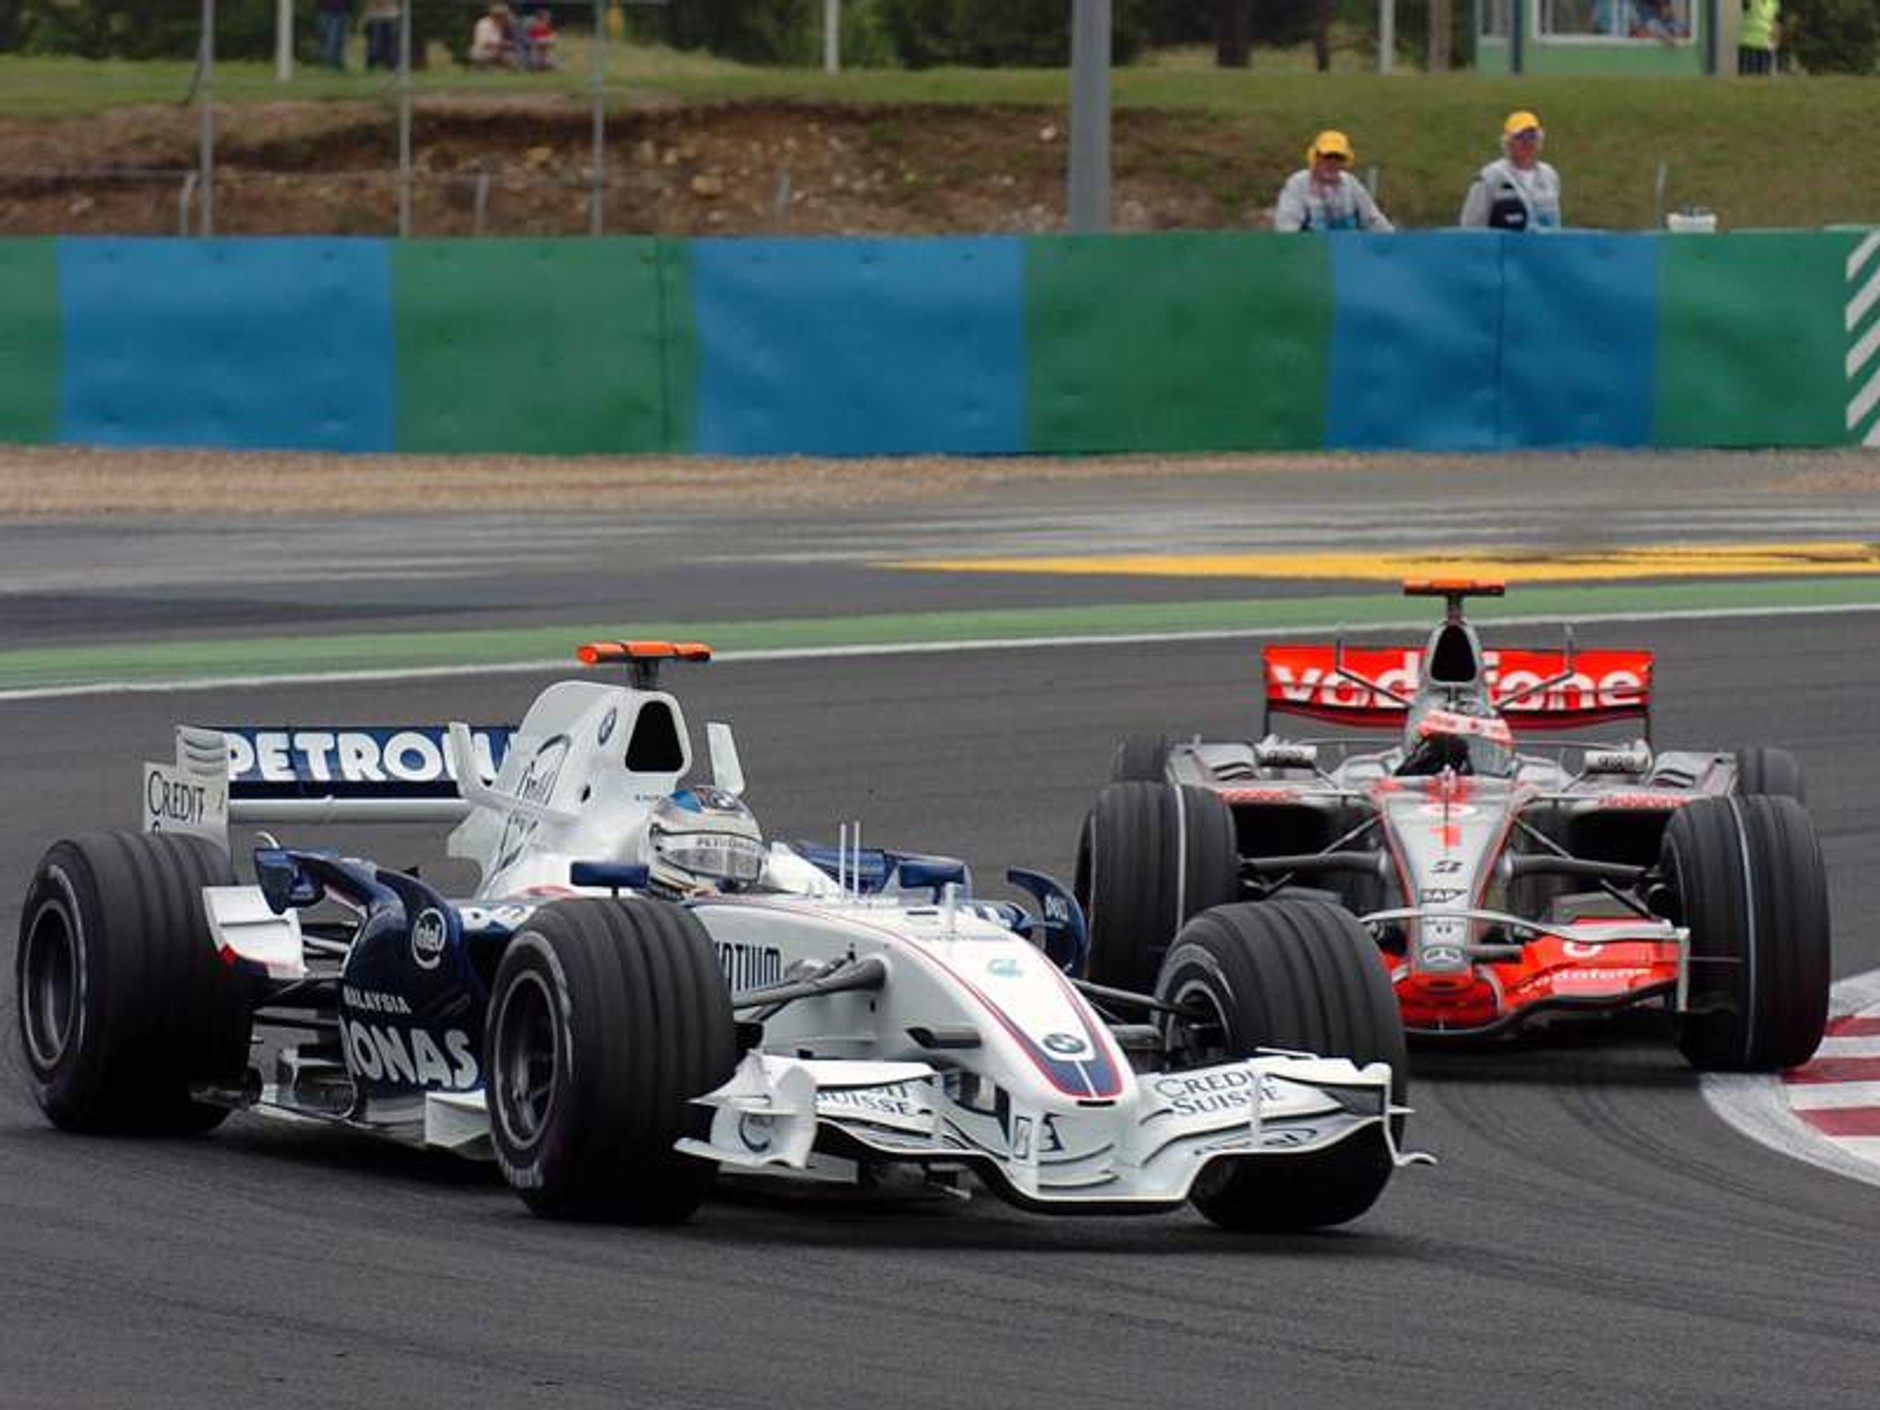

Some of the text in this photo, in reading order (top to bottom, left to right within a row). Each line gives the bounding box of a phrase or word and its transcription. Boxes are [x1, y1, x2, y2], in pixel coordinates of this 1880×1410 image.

[1270, 651, 1646, 711] vodone
[227, 732, 519, 782] PETRON
[148, 770, 206, 824] CREDIT
[714, 941, 780, 991] NTIUM
[1154, 1069, 1273, 1099] CREDI
